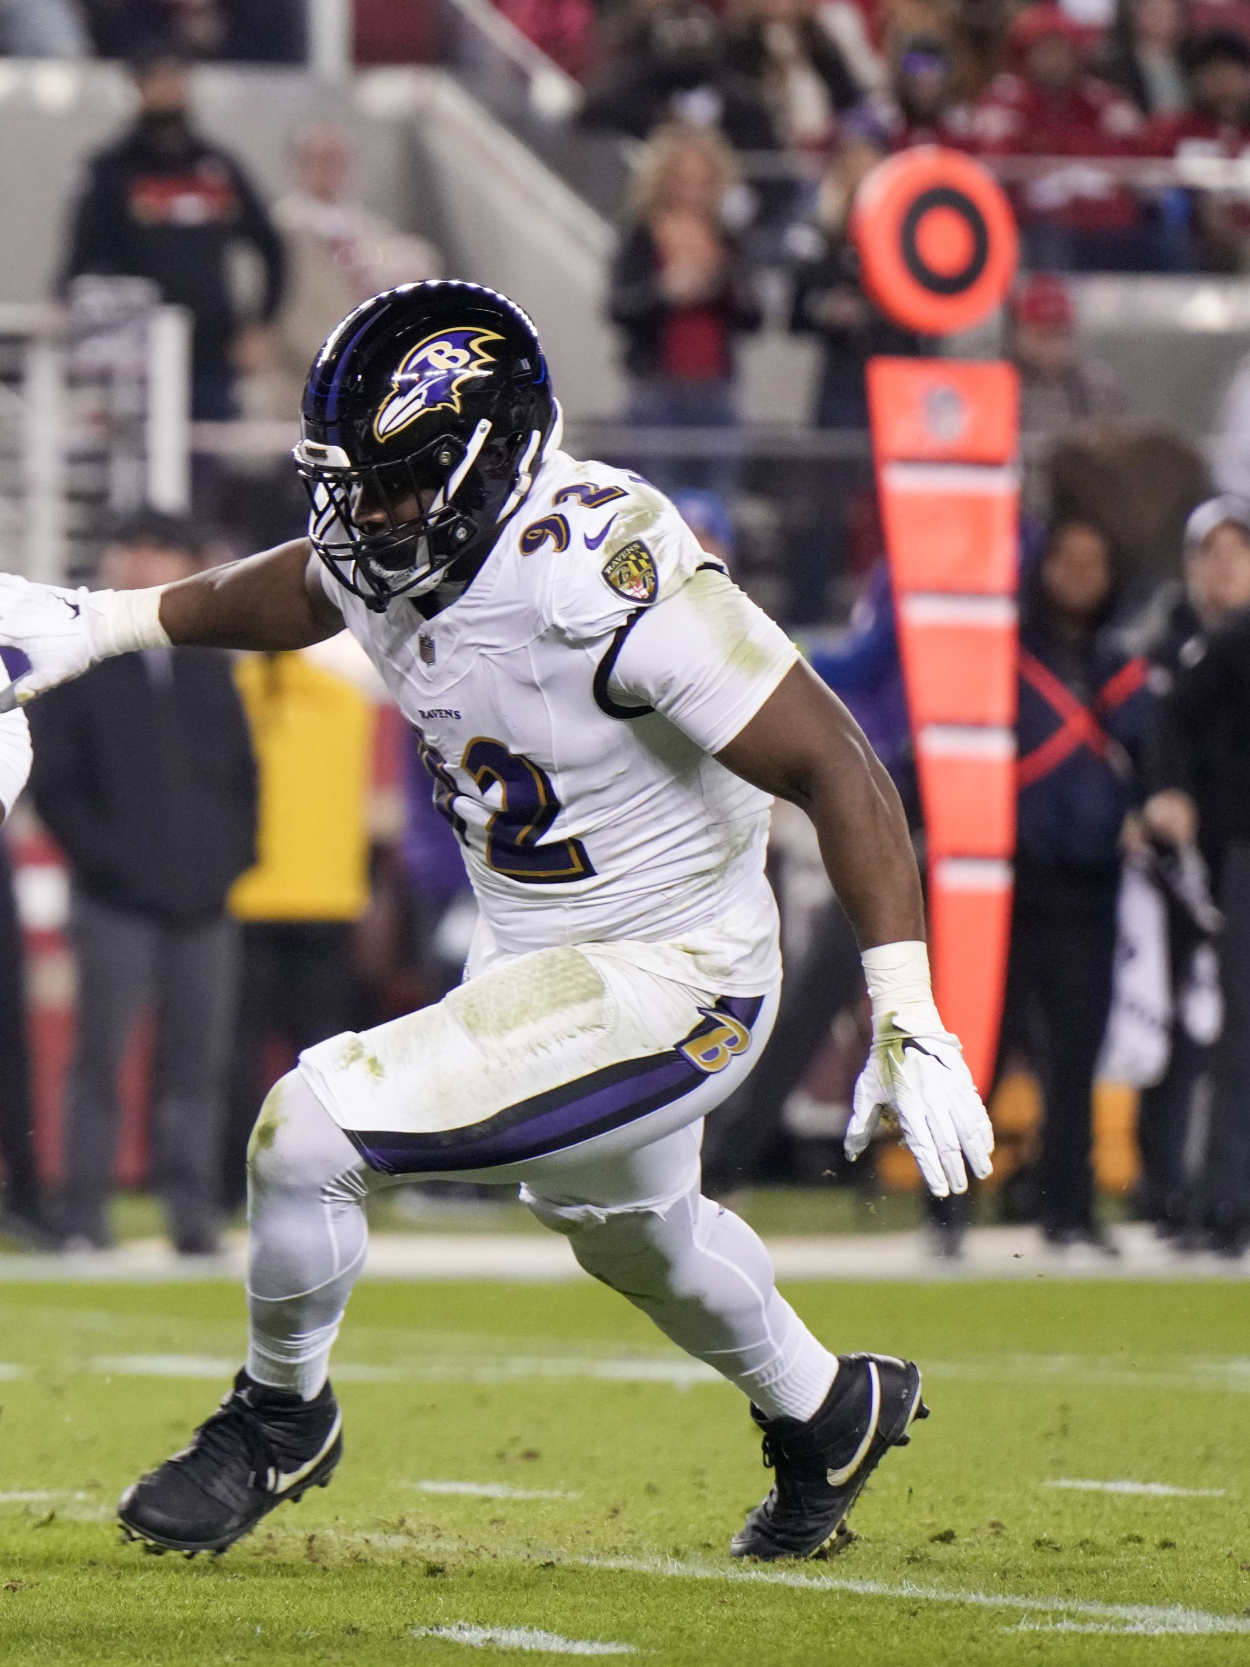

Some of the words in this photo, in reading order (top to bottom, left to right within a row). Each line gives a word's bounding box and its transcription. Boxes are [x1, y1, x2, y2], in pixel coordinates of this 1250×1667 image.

[519, 481, 630, 557] 92
[603, 541, 641, 576] RAVENS
[418, 709, 462, 720] RAVENS
[676, 1007, 752, 1074] B
